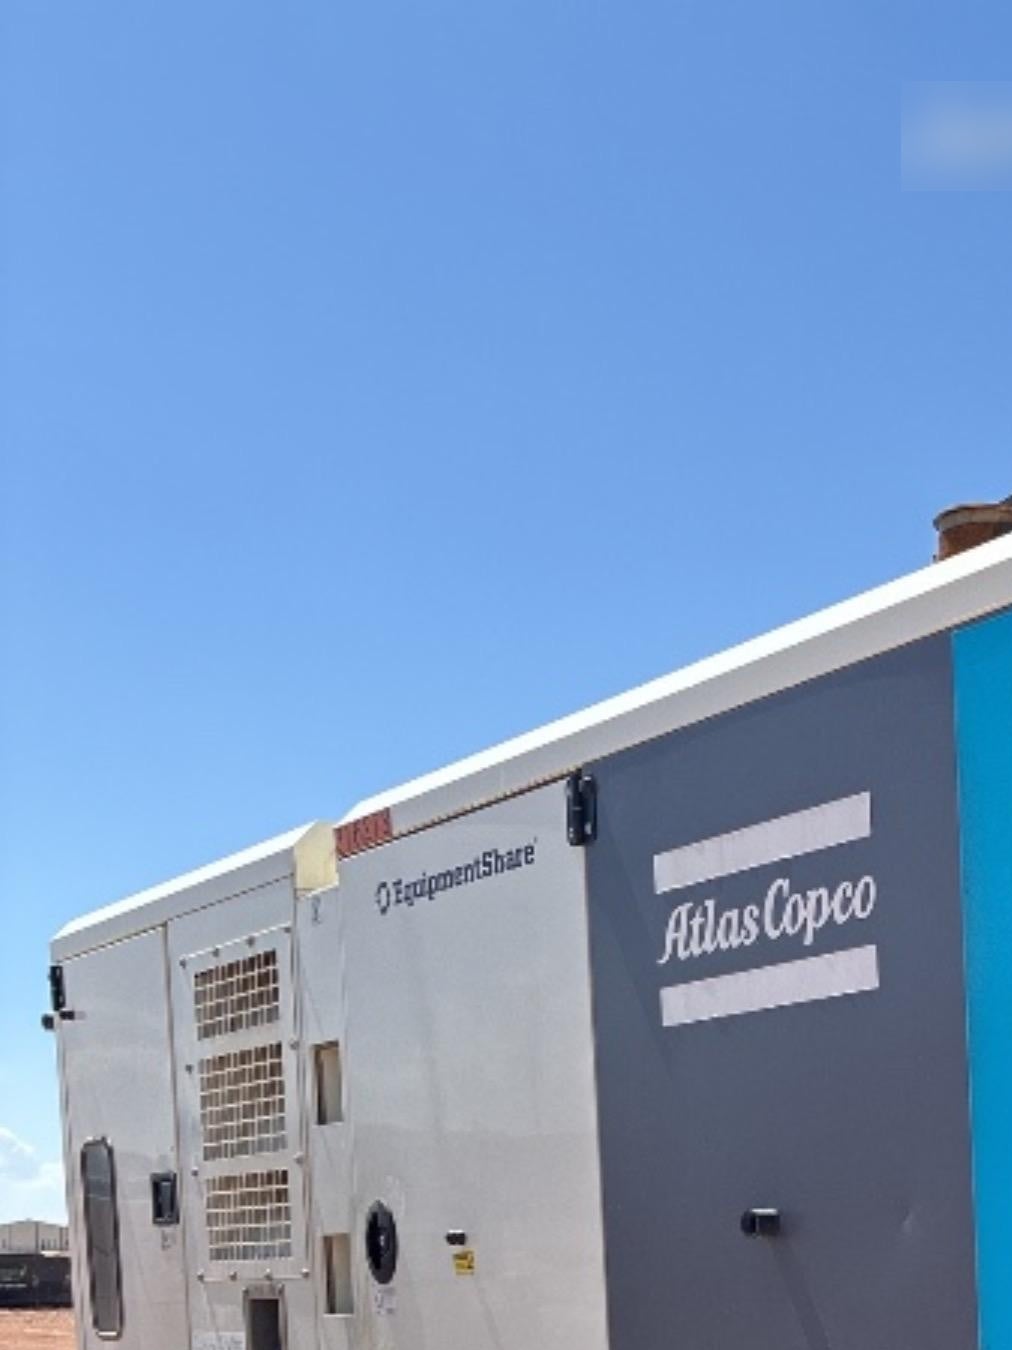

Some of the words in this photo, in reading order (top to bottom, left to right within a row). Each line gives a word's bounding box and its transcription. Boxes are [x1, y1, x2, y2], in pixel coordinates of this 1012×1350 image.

[392, 842, 537, 906] EquipmentShare
[656, 899, 760, 964] Atlas
[763, 875, 877, 946] Copco
